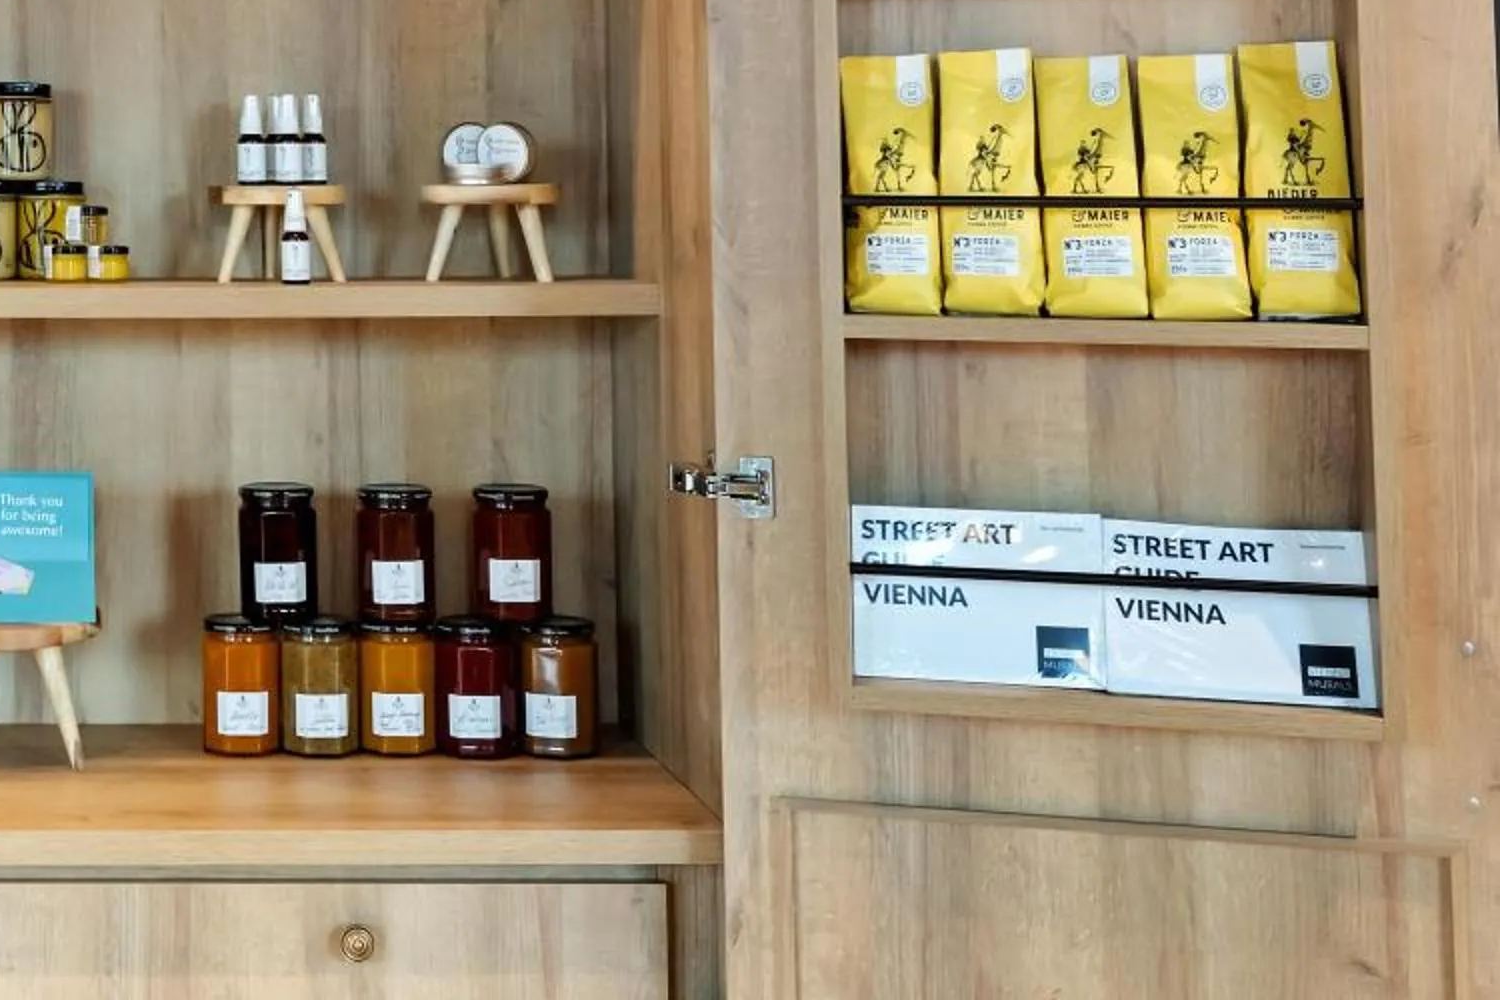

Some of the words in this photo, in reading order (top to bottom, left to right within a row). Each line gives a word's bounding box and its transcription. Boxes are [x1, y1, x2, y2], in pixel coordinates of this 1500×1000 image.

[889, 209, 929, 220] MAIER
[983, 209, 1025, 220] MAIER
[1087, 210, 1129, 221] MAIER
[1192, 211, 1231, 222] MAIE
[0, 493, 36, 506] Thank
[41, 497, 63, 509] you
[1, 508, 18, 520] for
[22, 508, 56, 525] being
[861, 519, 956, 542] STREET
[963, 523, 1015, 545] ART
[1113, 533, 1212, 561] STREET
[1218, 541, 1274, 563] ART
[863, 582, 968, 608] VIENNA
[1116, 597, 1227, 625] VIENNA
